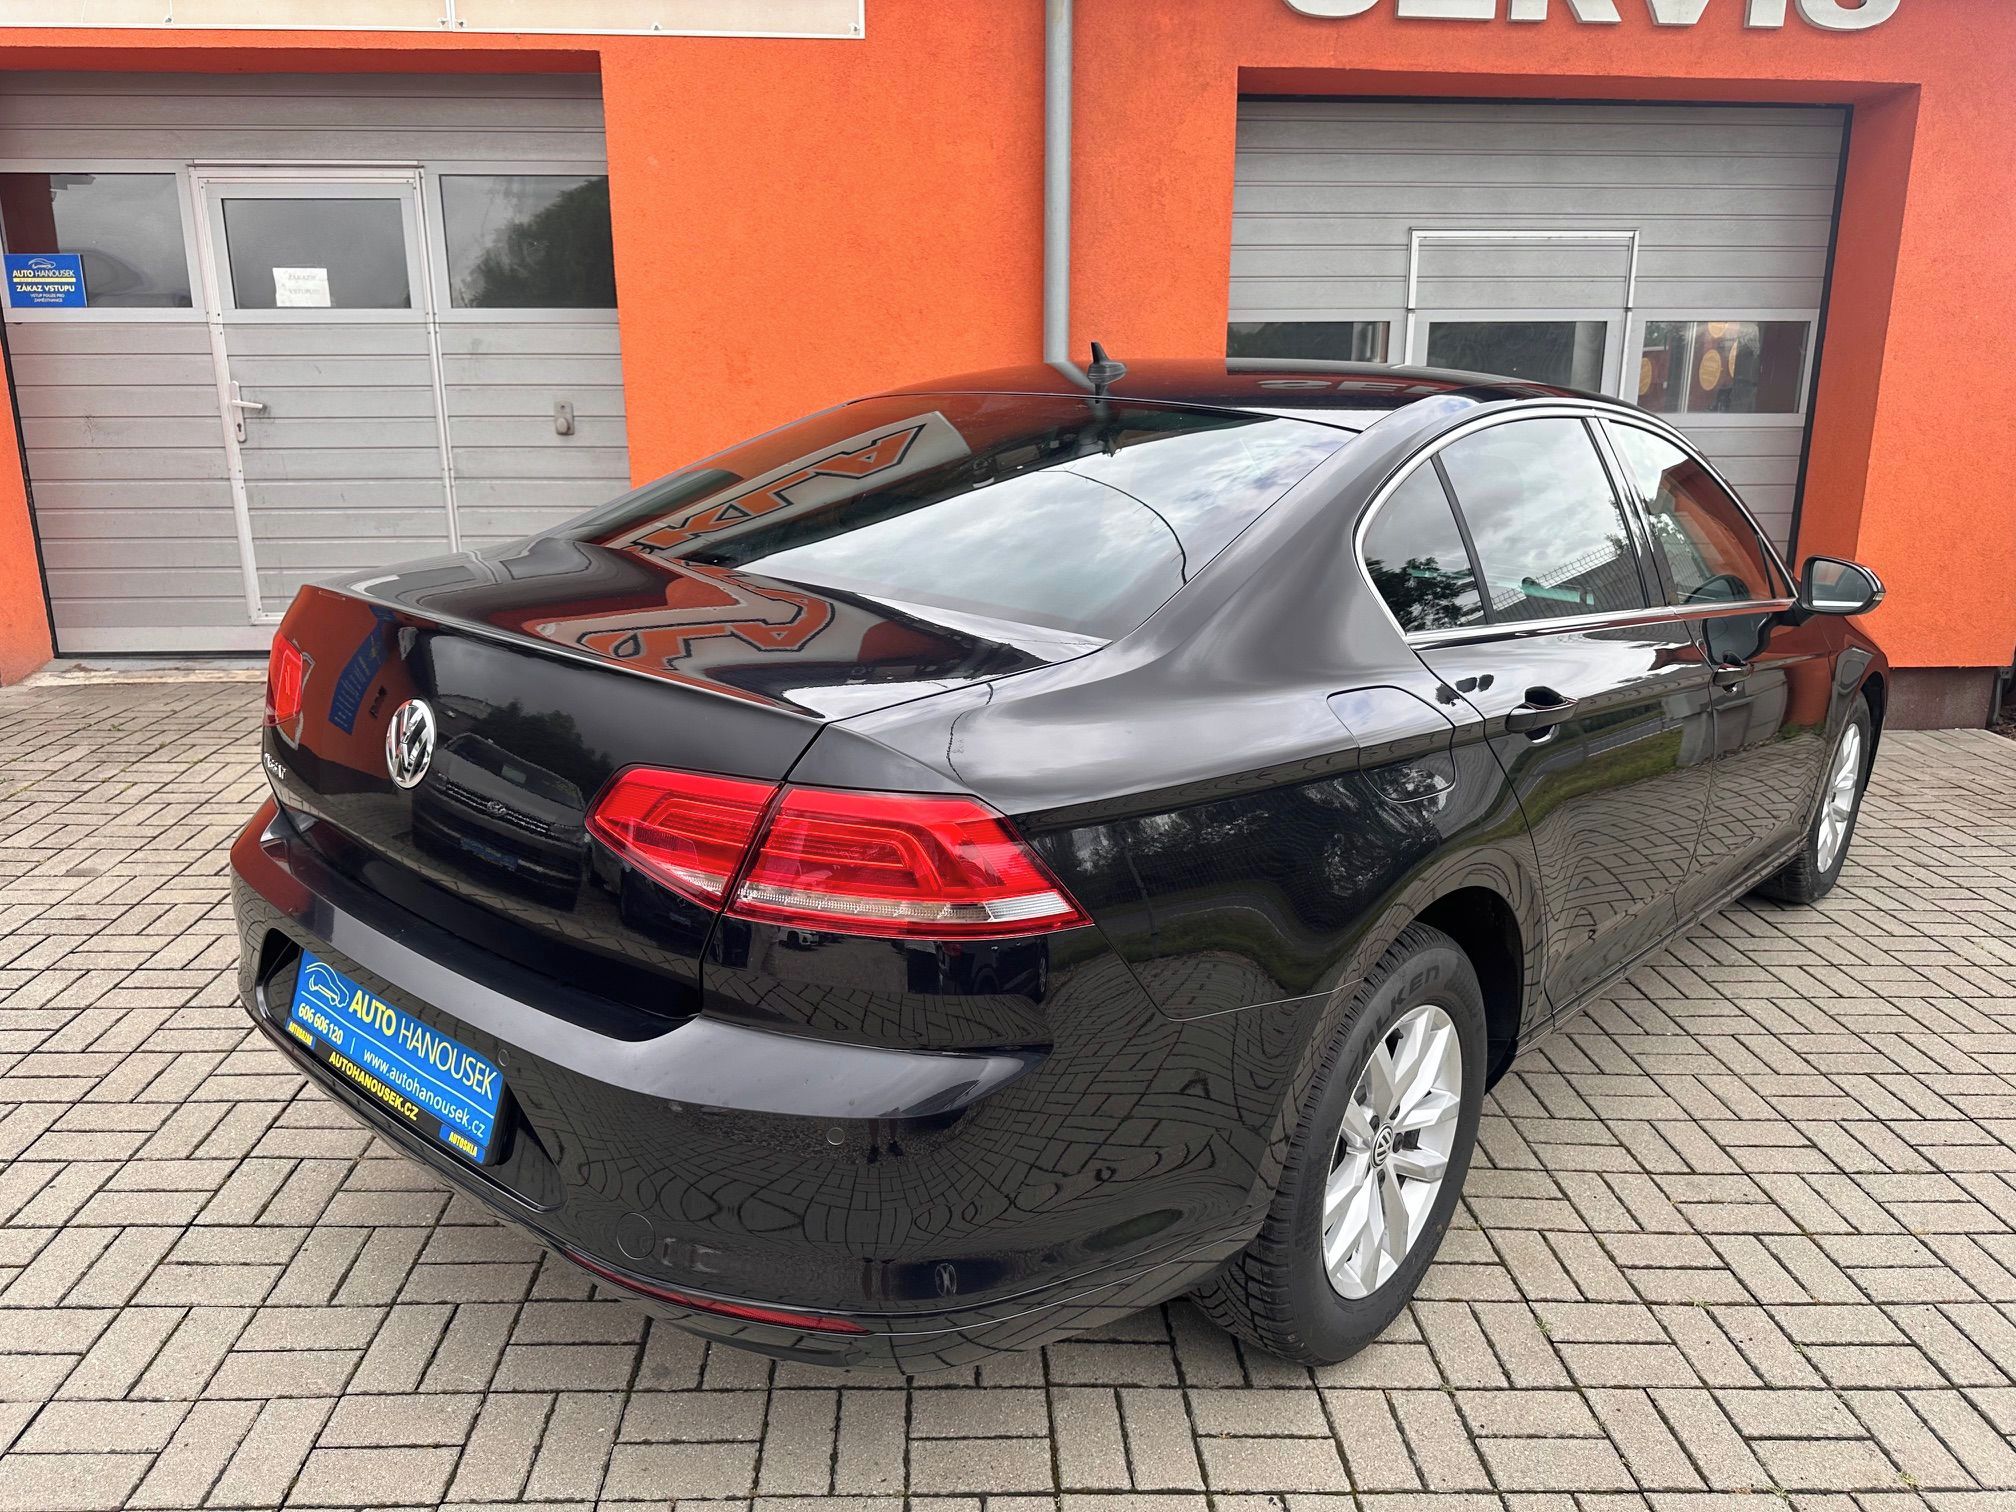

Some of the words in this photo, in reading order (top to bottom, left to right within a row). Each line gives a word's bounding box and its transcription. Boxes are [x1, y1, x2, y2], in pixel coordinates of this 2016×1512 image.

[16, 283, 43, 292] ZÁKAZ
[44, 284, 75, 292] VSTUPU
[298, 1003, 315, 1023] 606
[313, 1013, 330, 1034] 606
[329, 1023, 344, 1045] 120
[348, 990, 397, 1037] AUTO
[398, 1018, 498, 1101] HANOUSEK
[329, 1051, 421, 1121] AUTOHANOUSEK.CZ
[363, 1048, 485, 1138] www.autohanousek.cz
[448, 1131, 478, 1157] AUTOSKLA
